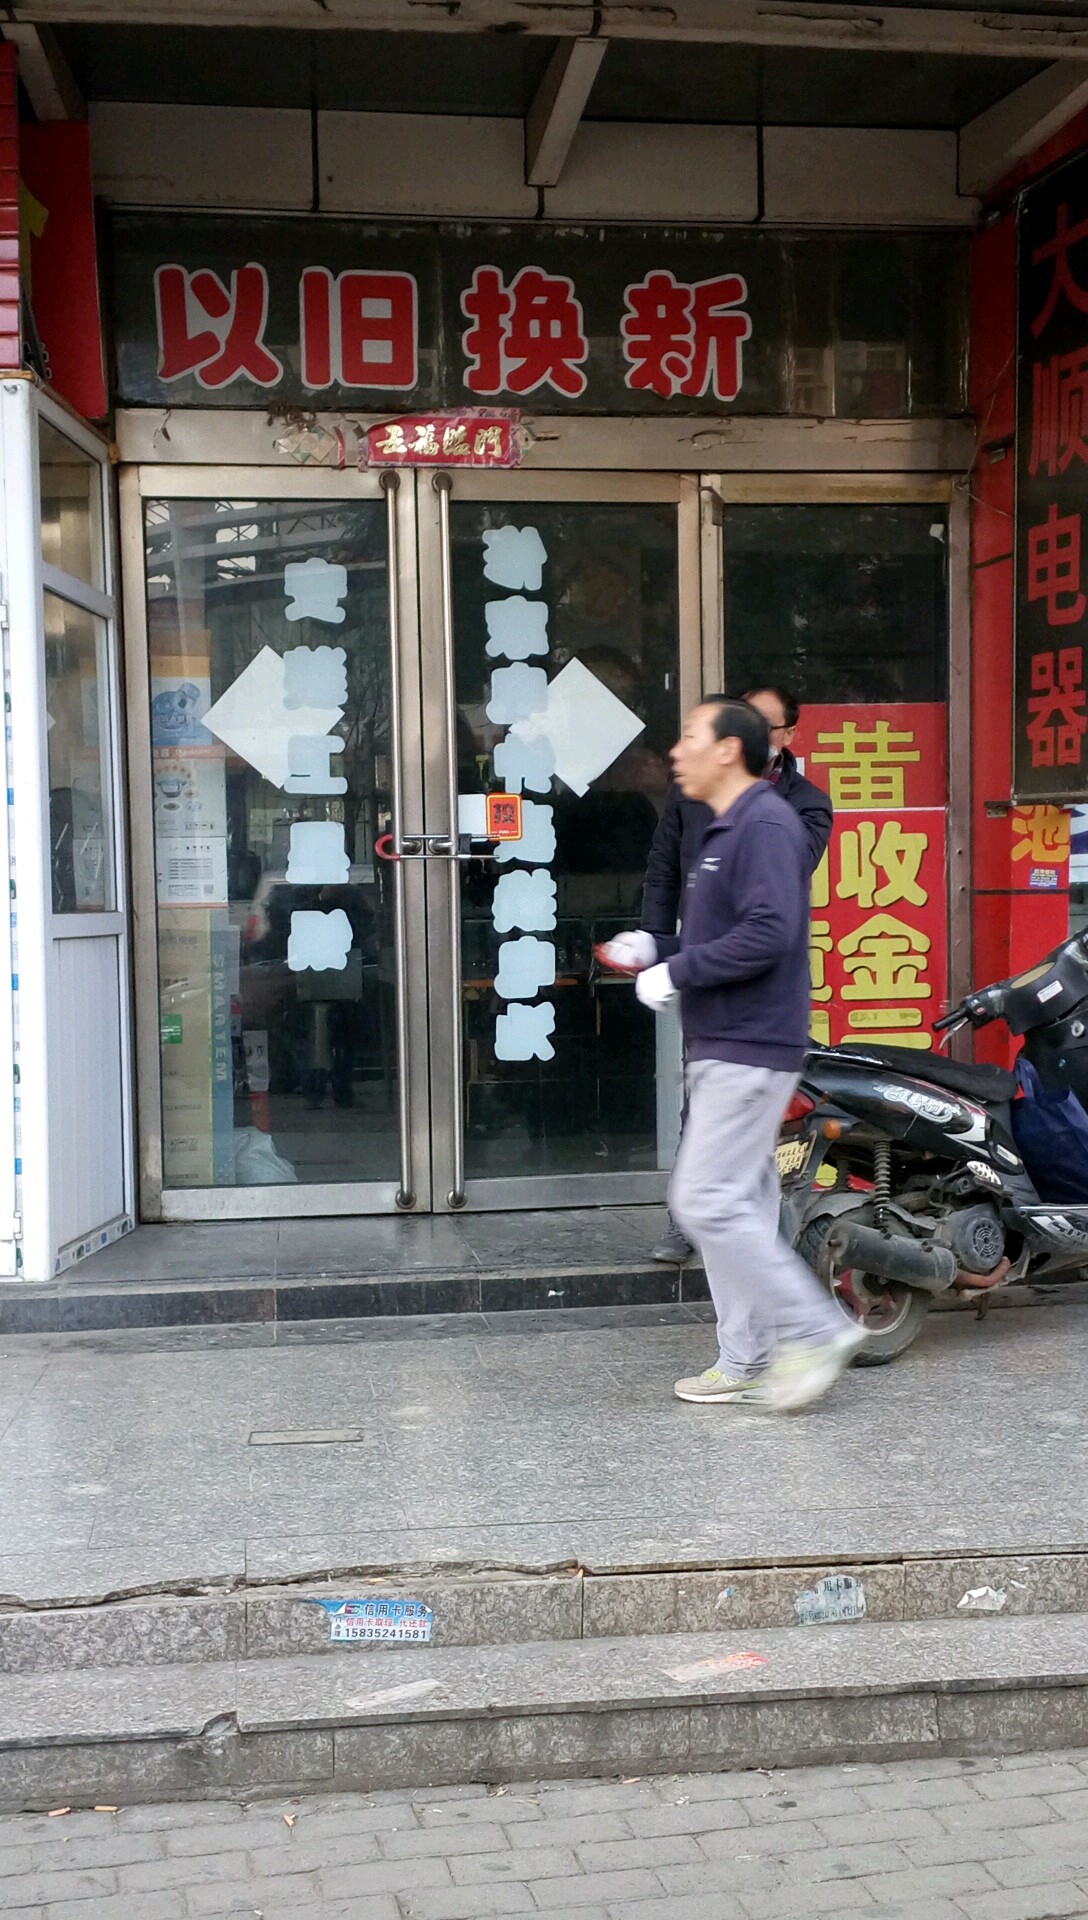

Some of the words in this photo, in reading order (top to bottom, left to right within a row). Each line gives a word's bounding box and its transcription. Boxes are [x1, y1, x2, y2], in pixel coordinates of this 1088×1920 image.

[154, 261, 753, 402] 以旧换新
[1027, 201, 1088, 769] 大顺电器
[811, 720, 921, 809] 黄
[1011, 804, 1071, 862] 池
[344, 1628, 427, 1640] 15835241581
[364, 1603, 429, 1618] 信用卡服务
